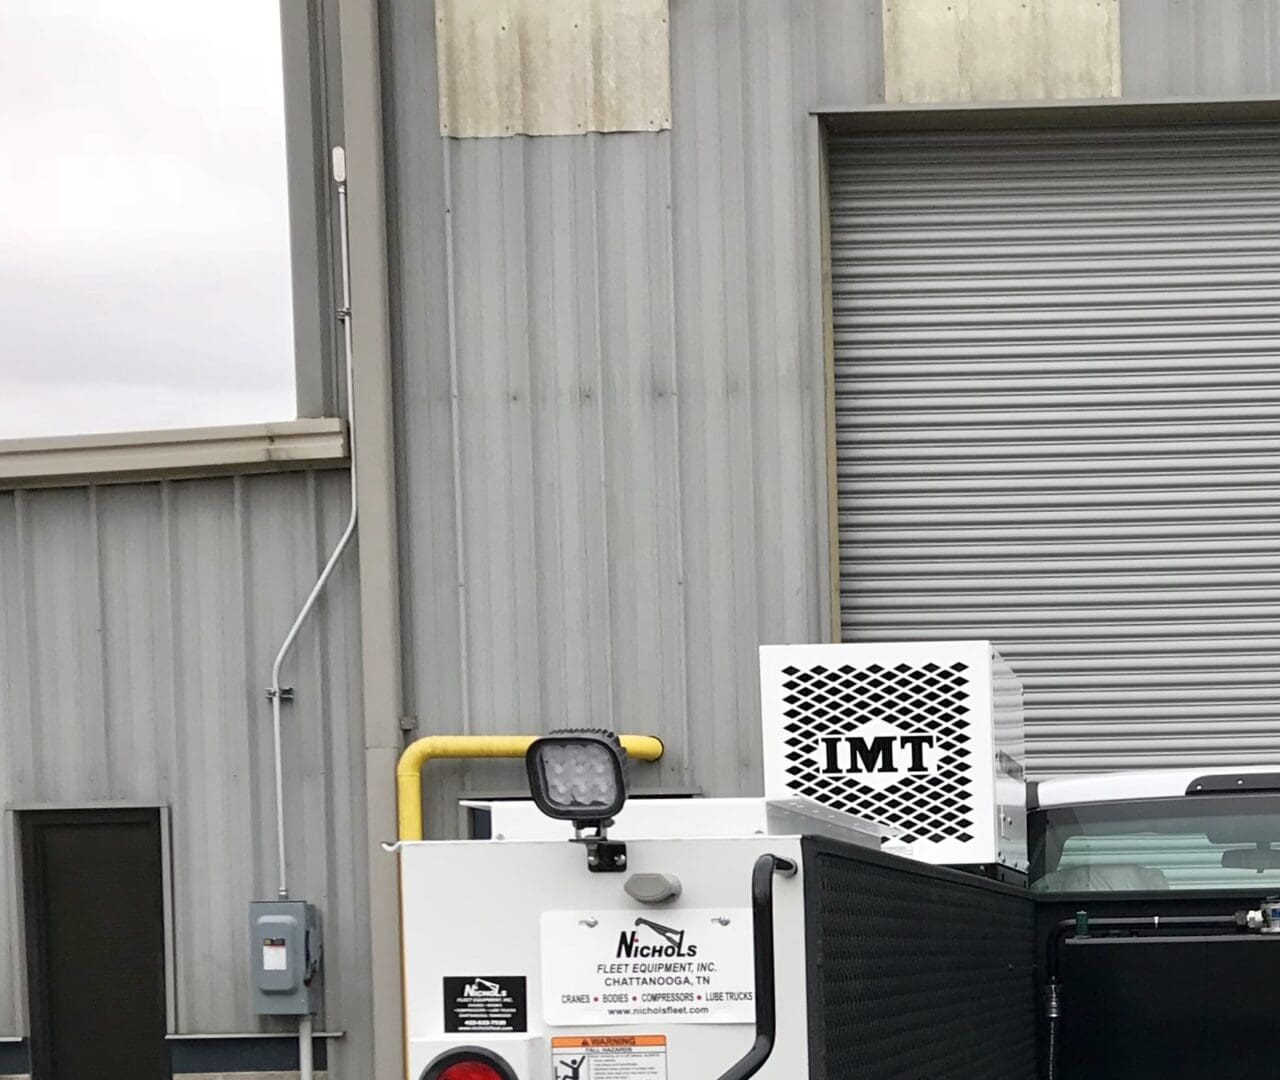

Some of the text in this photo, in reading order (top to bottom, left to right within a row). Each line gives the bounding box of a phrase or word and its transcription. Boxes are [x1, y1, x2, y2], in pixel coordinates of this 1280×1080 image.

[821, 735, 934, 774] IMT
[597, 962, 717, 974] FLEET EQUIPMENT, INC.
[604, 976, 710, 987] CHATTANOOGA, TN
[561, 991, 752, 1004] CRANES BODIES COMPRESSORS LUBE TRUCKS
[608, 1006, 709, 1015] www.nicholsfleet.com
[592, 1037, 636, 1046] WARNING
